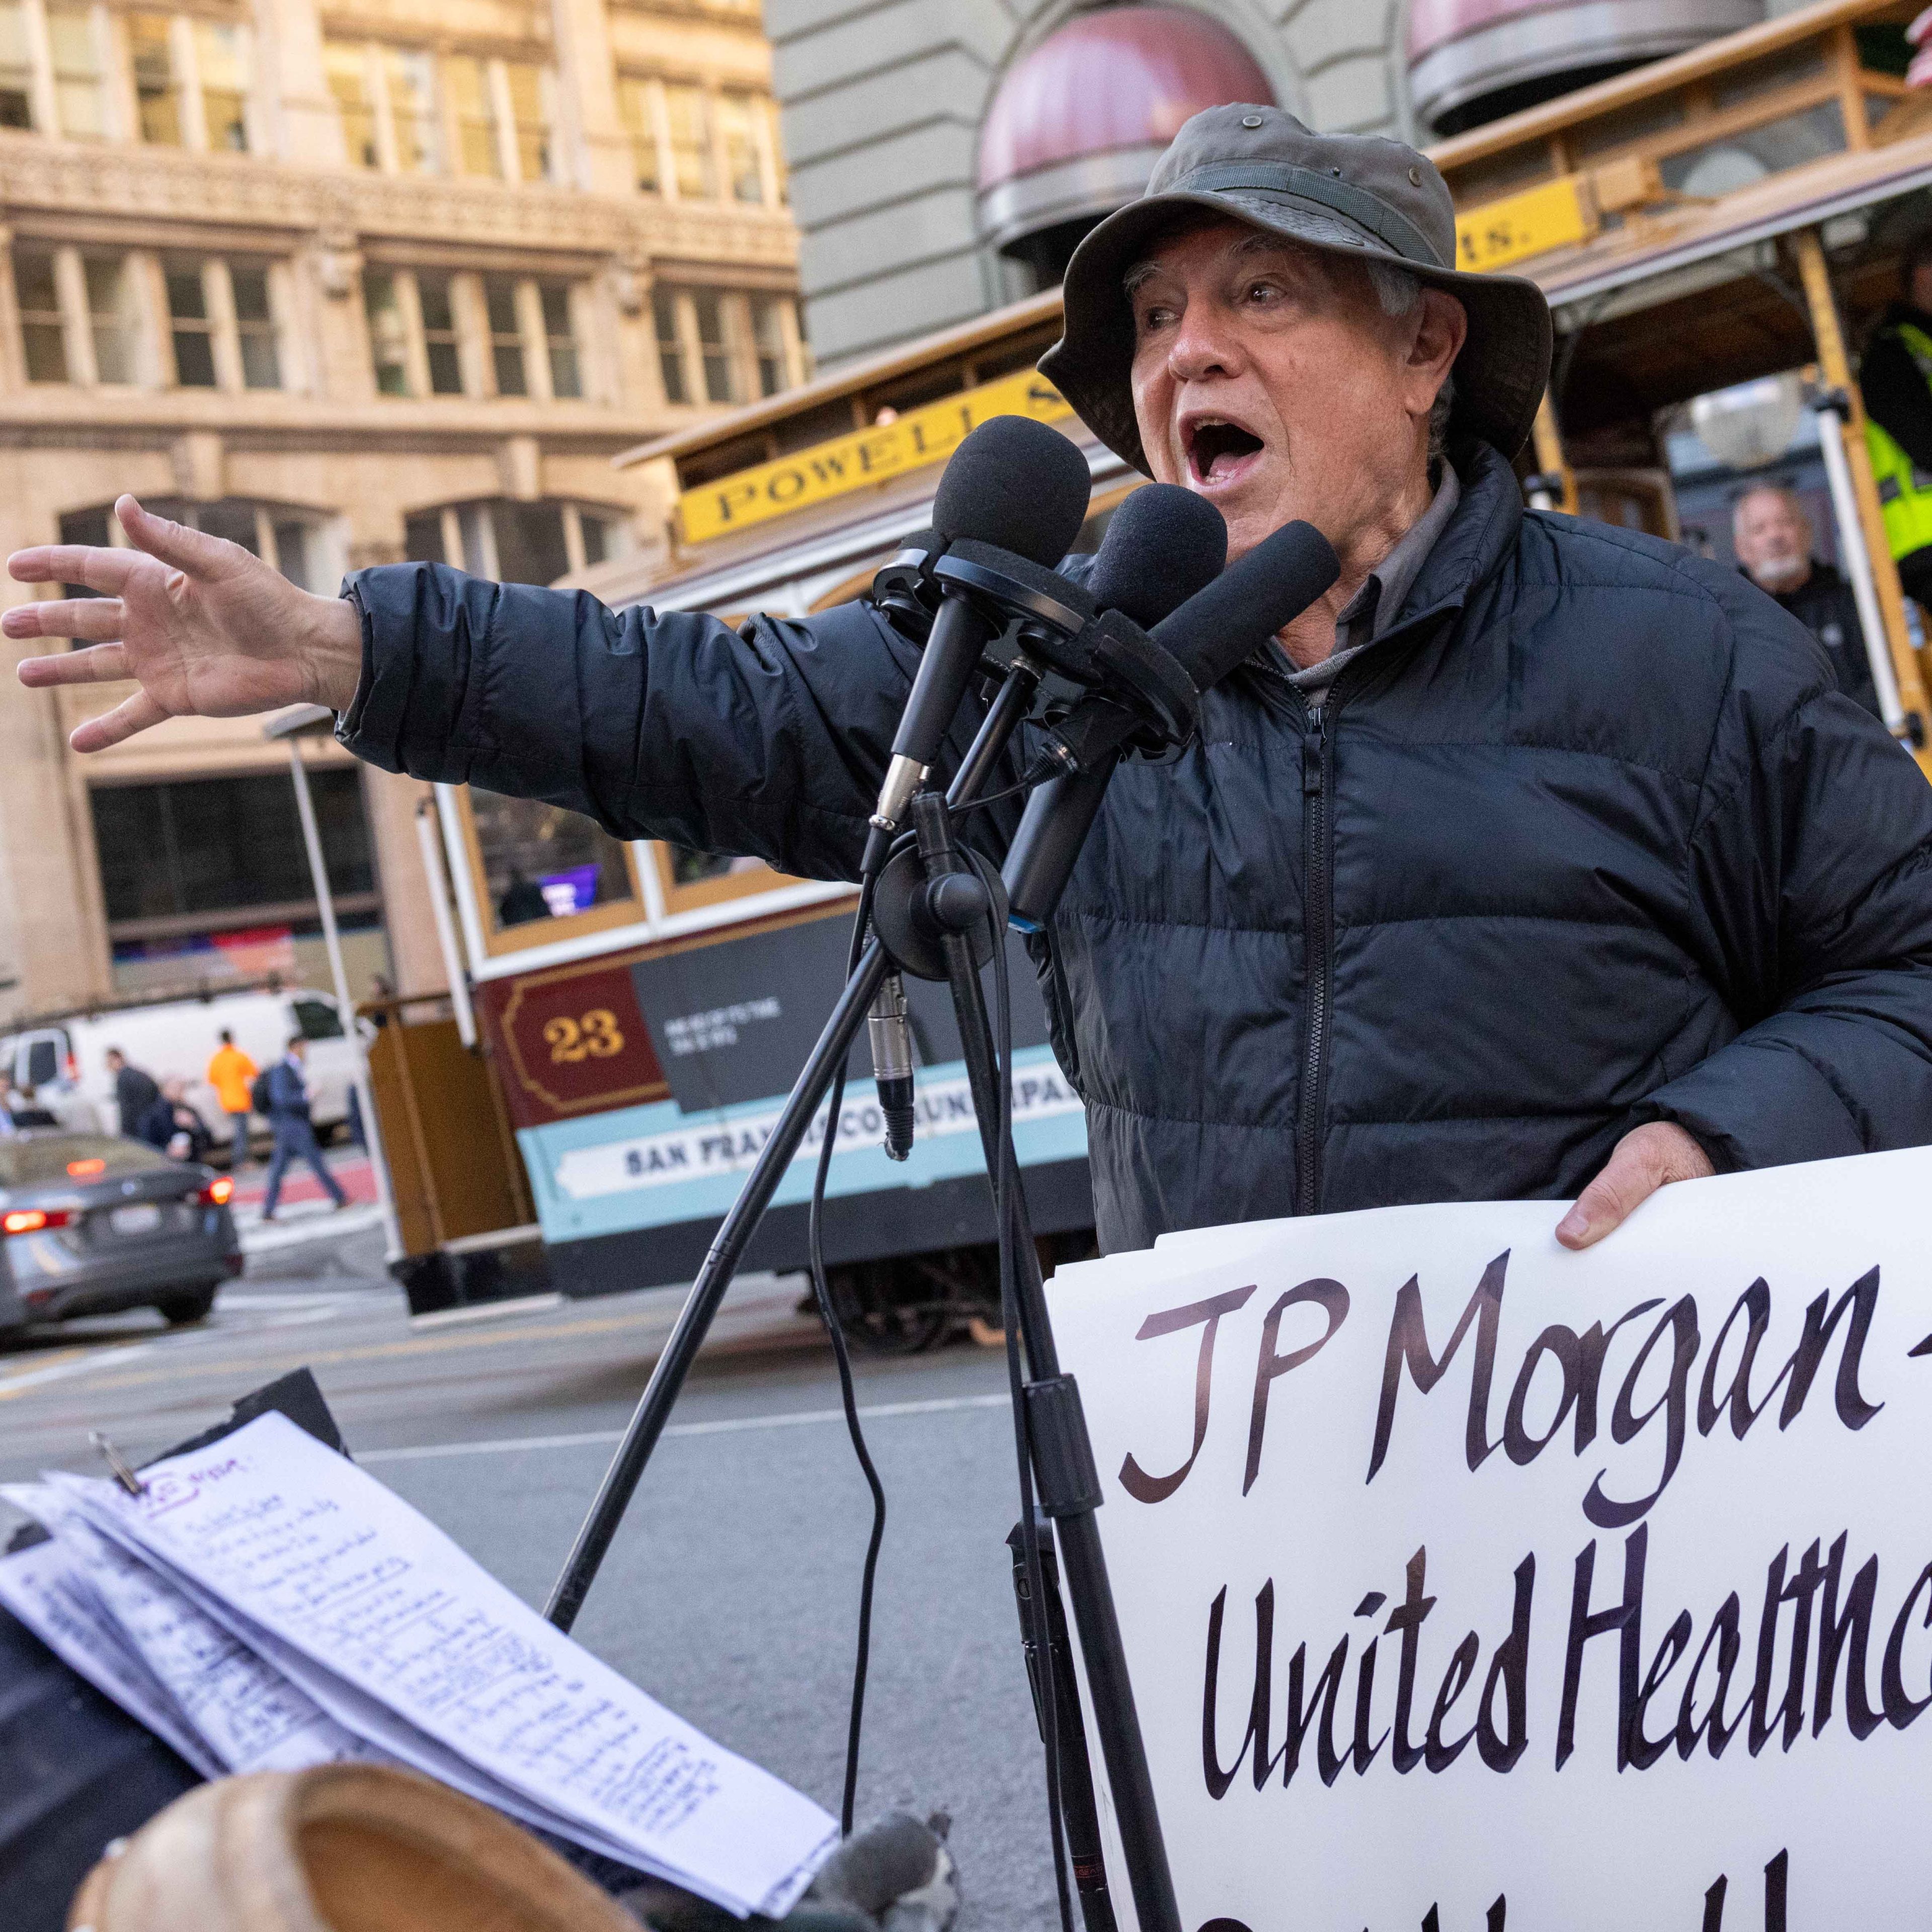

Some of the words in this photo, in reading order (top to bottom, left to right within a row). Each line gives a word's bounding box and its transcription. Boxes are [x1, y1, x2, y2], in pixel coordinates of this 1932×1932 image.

[544, 1009, 624, 1062] 23
[625, 1144, 688, 1177] SAN
[1118, 1278, 1349, 1503] JP
[1366, 1248, 1885, 1528] Morgan
[1202, 1545, 1536, 1800] United
[1556, 1521, 1932, 1774] Healthc
